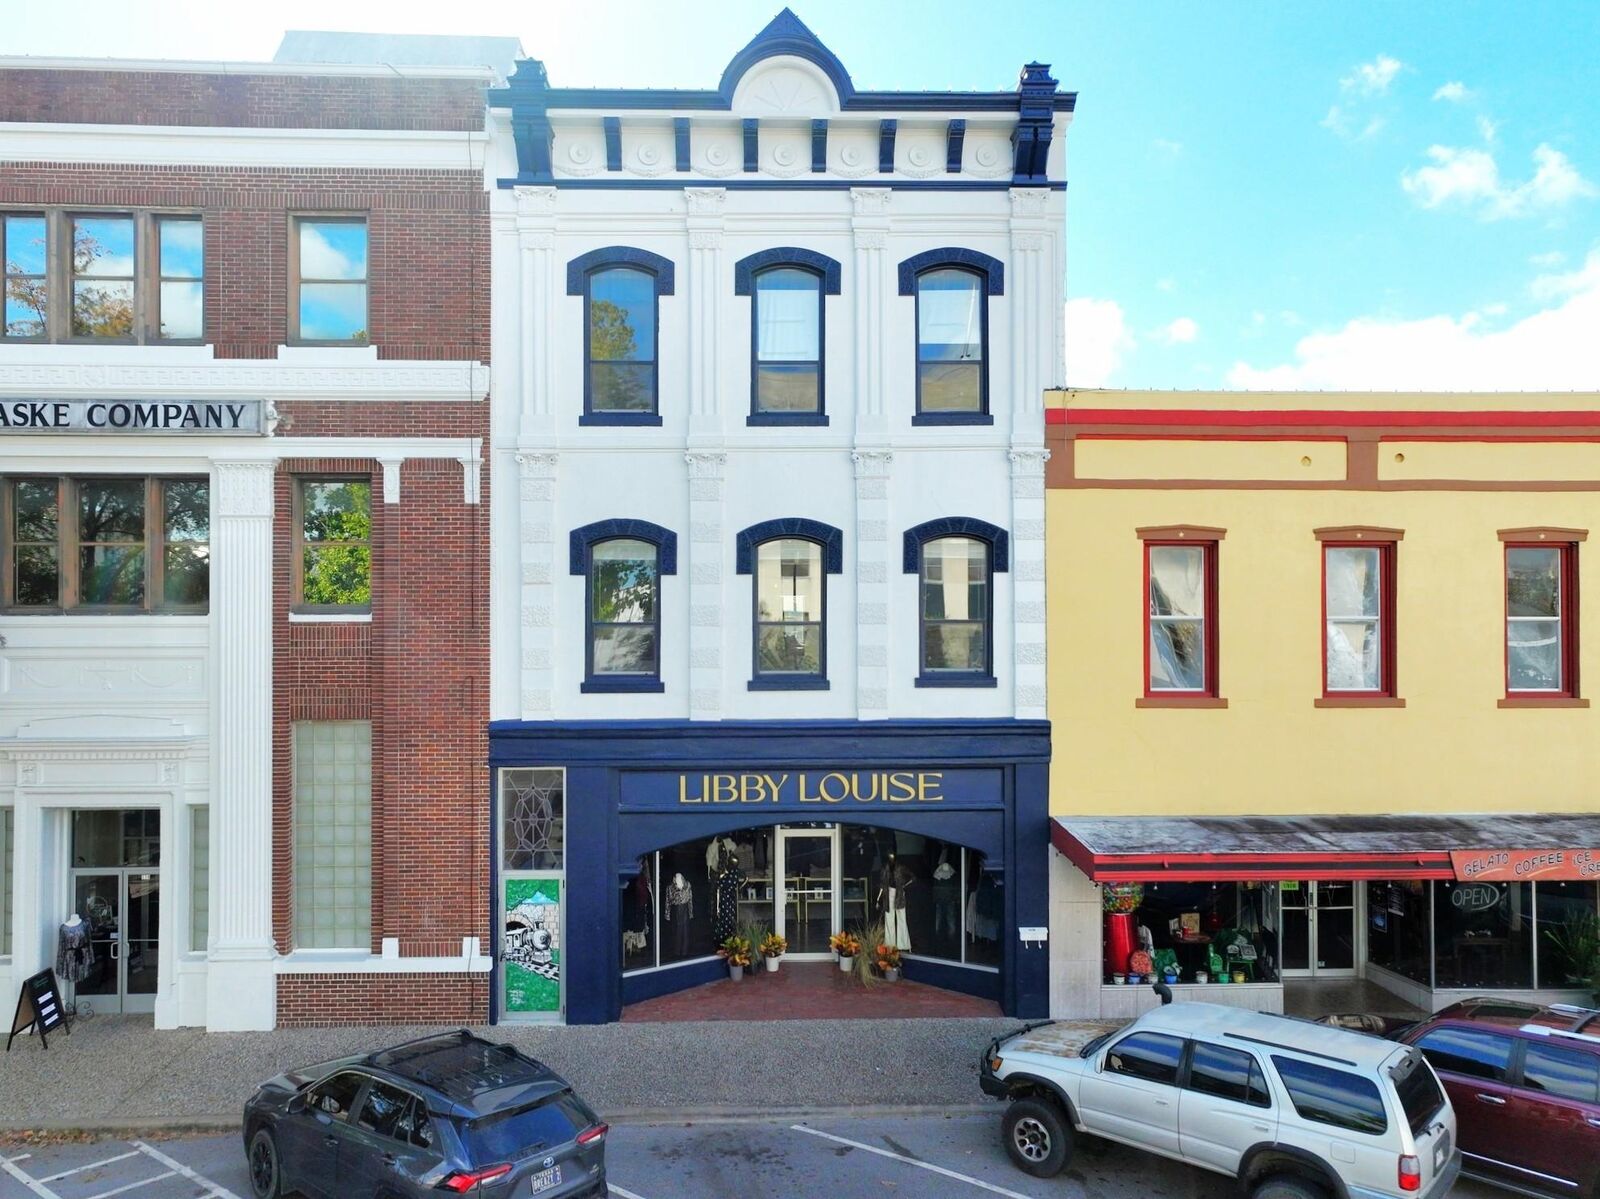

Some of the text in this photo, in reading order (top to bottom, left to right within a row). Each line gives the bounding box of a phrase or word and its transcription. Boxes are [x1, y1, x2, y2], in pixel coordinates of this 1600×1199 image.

[0, 403, 246, 428] ASKE COMPANY
[679, 771, 943, 803] LIBBY LOUISE
[1463, 853, 1509, 876] GELATO
[1515, 852, 1563, 875] COFFEE
[1452, 888, 1491, 906] OPEN
